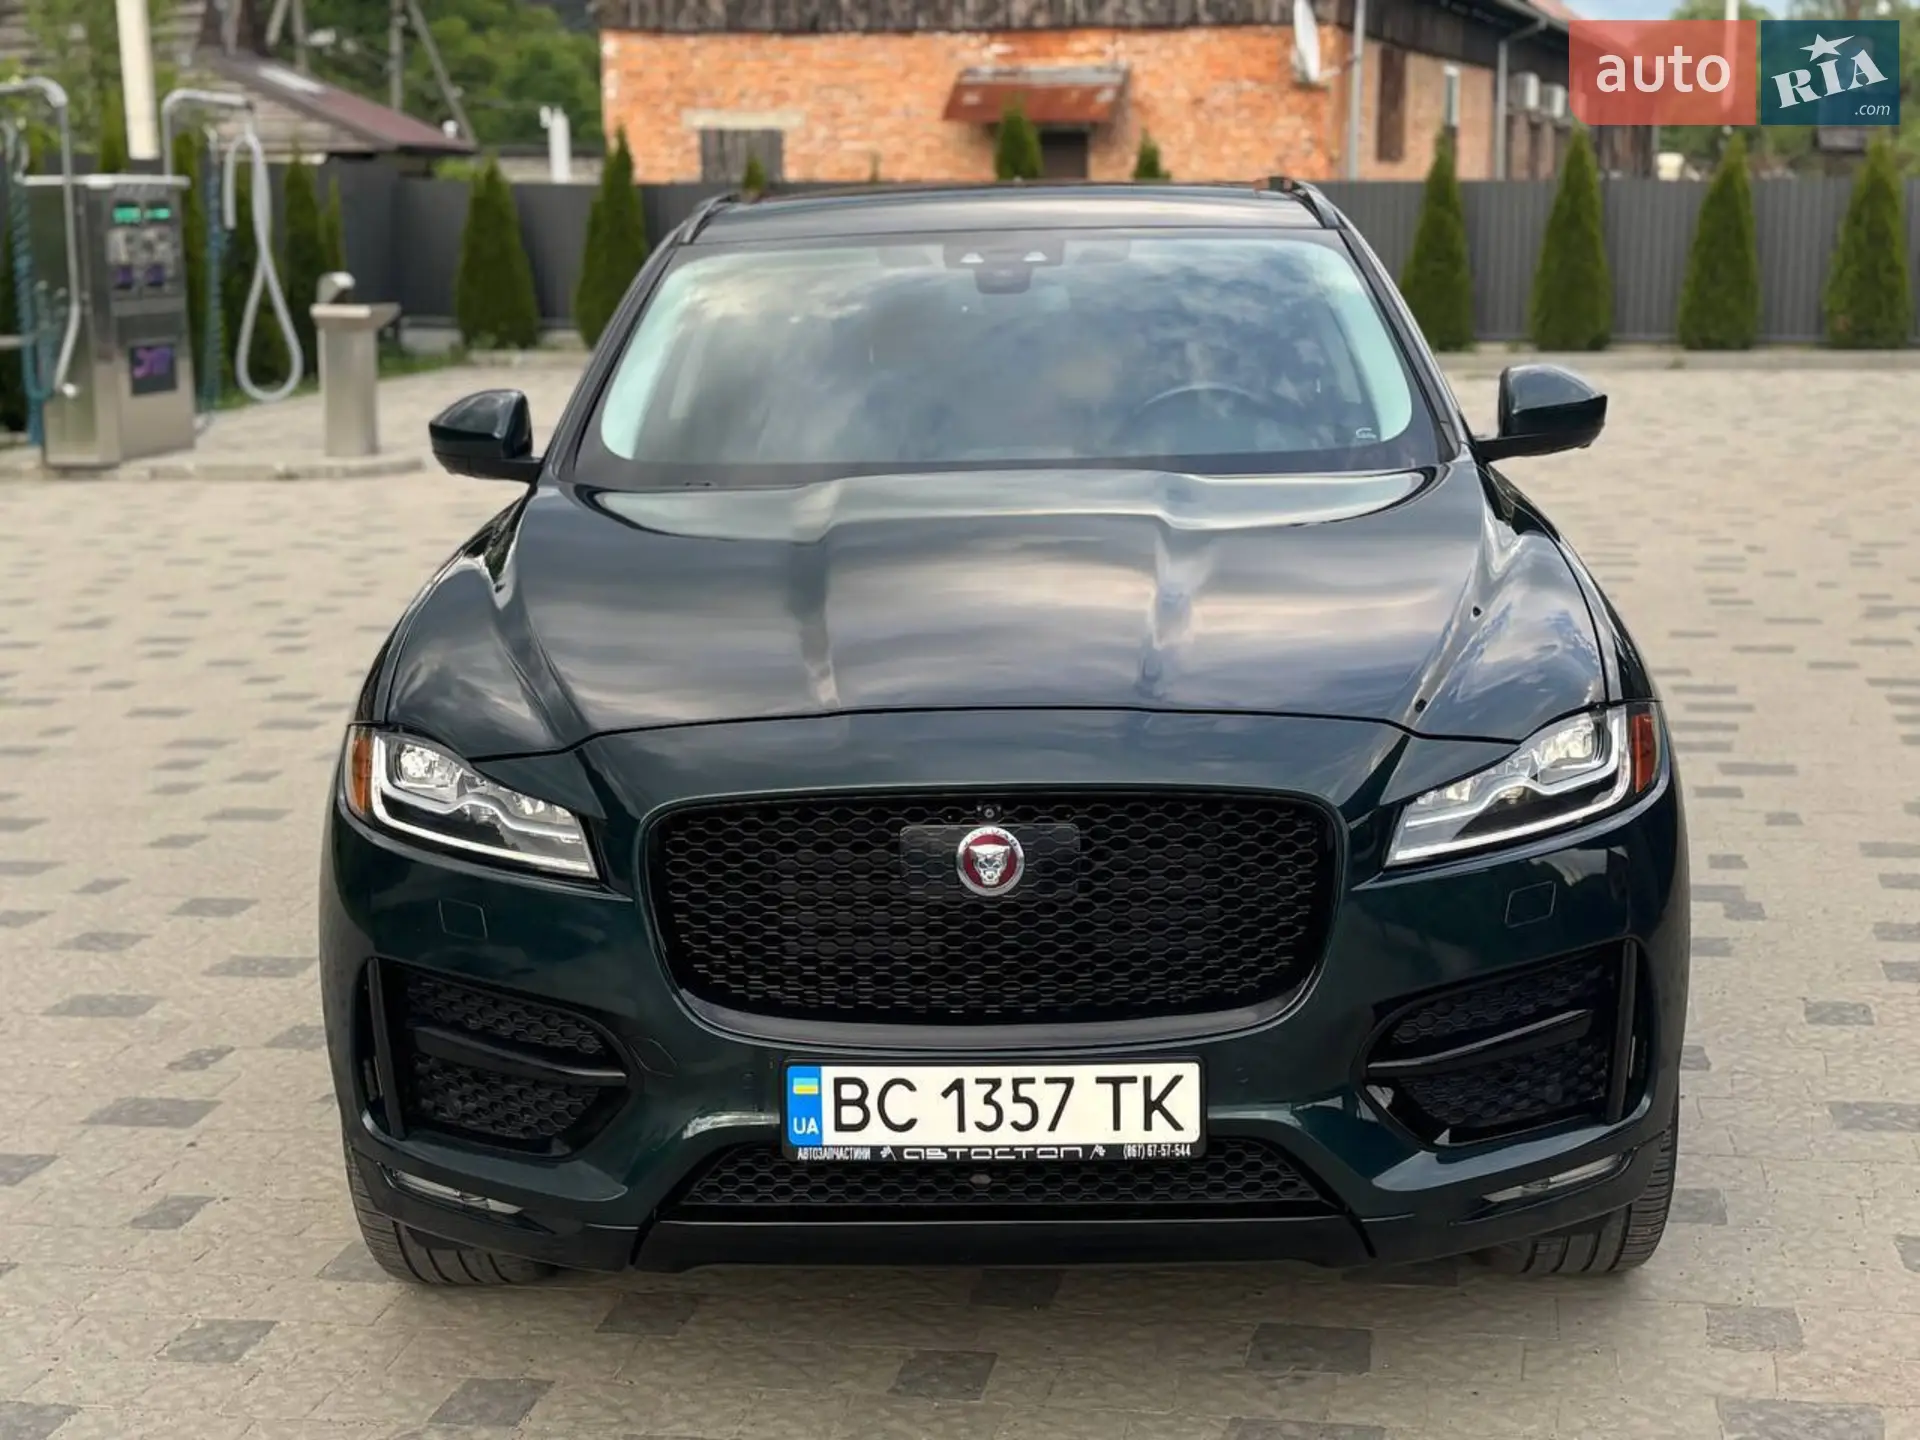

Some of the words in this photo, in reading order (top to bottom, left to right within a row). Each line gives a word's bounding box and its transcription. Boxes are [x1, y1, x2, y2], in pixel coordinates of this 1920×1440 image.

[833, 1077, 918, 1132] BC
[940, 1077, 1075, 1132] 1357
[1095, 1074, 1185, 1131] TK
[793, 1117, 819, 1135] UA
